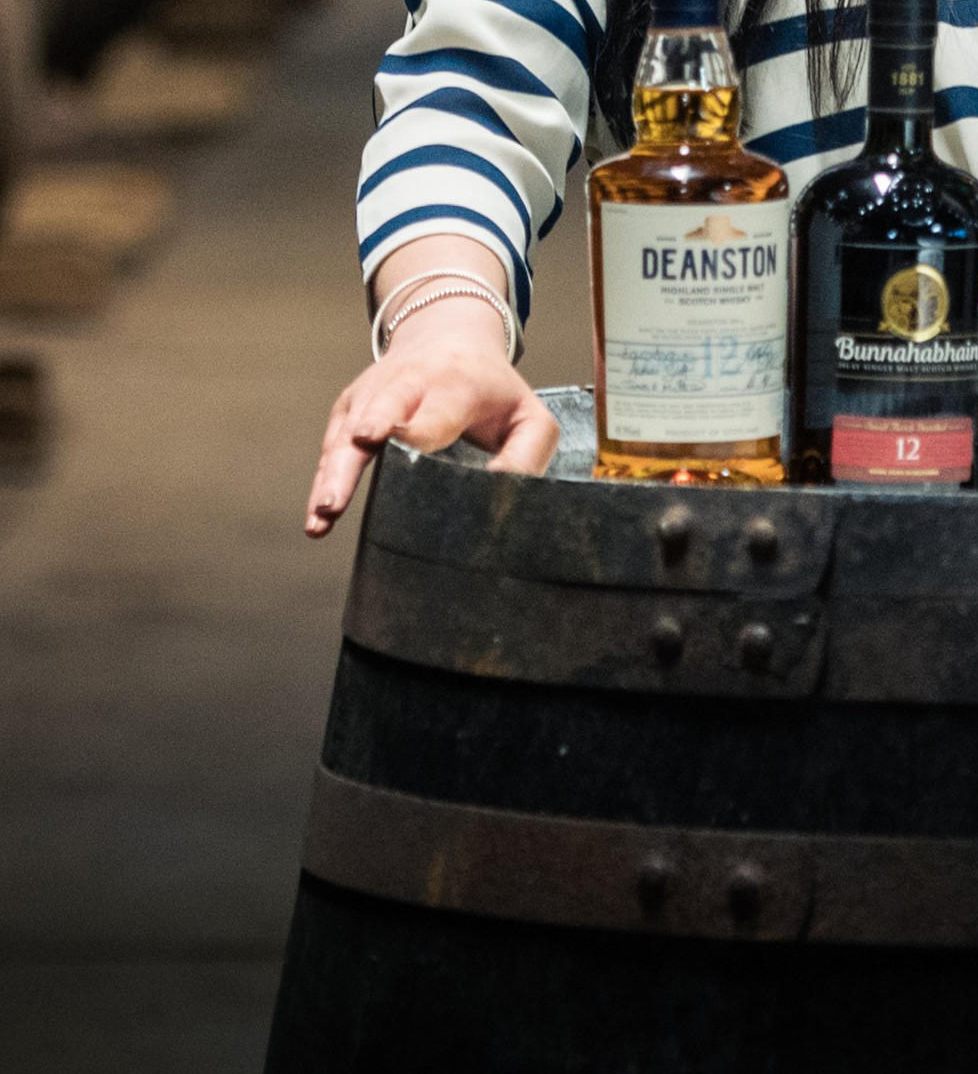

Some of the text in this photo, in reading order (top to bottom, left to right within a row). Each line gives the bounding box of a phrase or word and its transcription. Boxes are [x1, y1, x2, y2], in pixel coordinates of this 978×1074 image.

[642, 244, 777, 281] DEANSTON
[660, 287, 710, 296] HIGHLAND
[678, 297, 716, 306] SCOTCH
[703, 335, 742, 378] 12
[896, 436, 920, 461] 12
